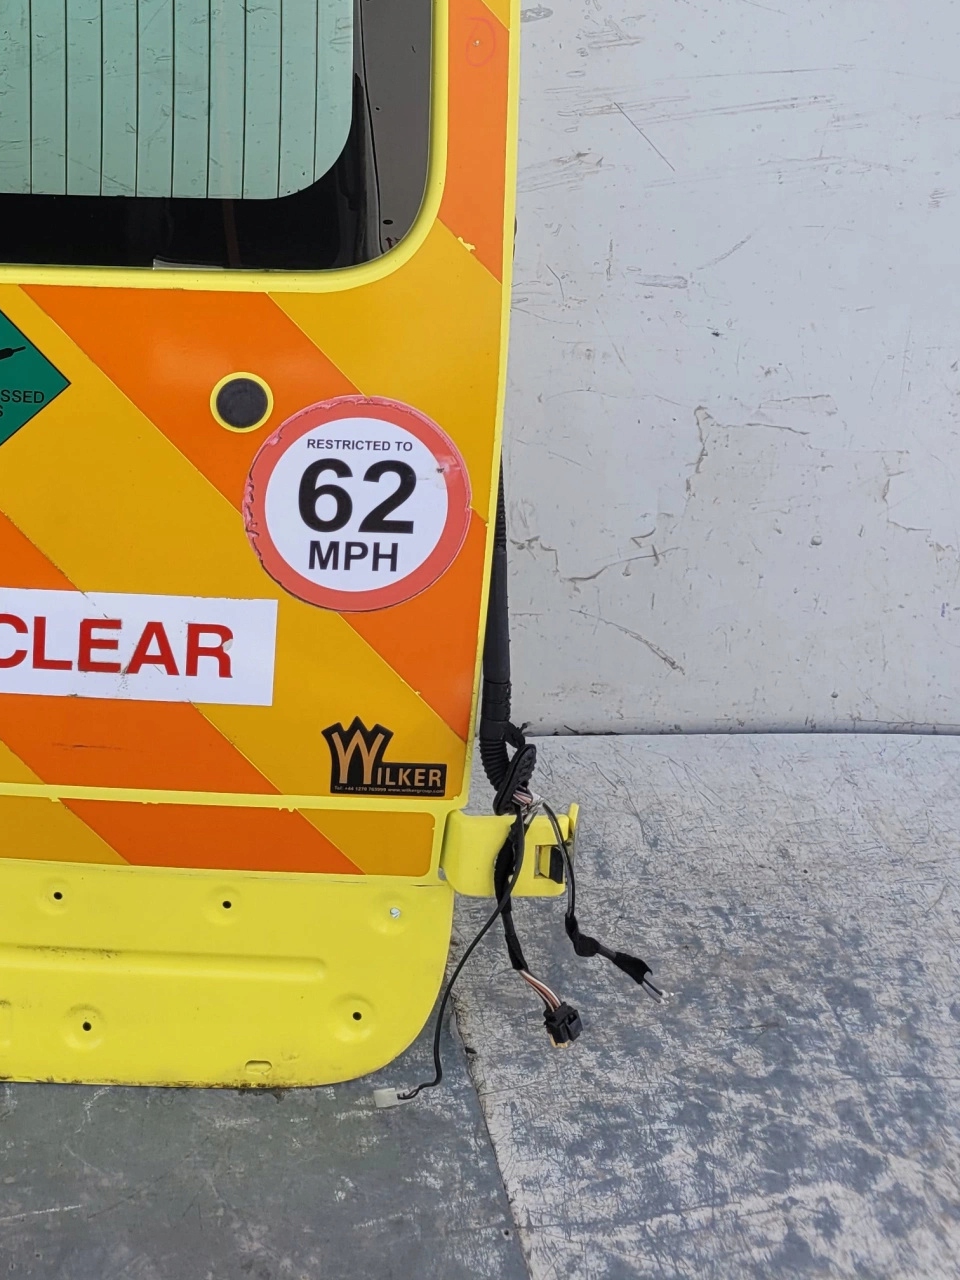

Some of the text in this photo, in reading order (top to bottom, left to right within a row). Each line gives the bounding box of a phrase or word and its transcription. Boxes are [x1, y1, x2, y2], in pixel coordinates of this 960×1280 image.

[307, 438, 413, 452] RESTRICTED TO
[298, 458, 417, 535] 62
[308, 540, 399, 572] MPH
[331, 729, 441, 787] WILKER
